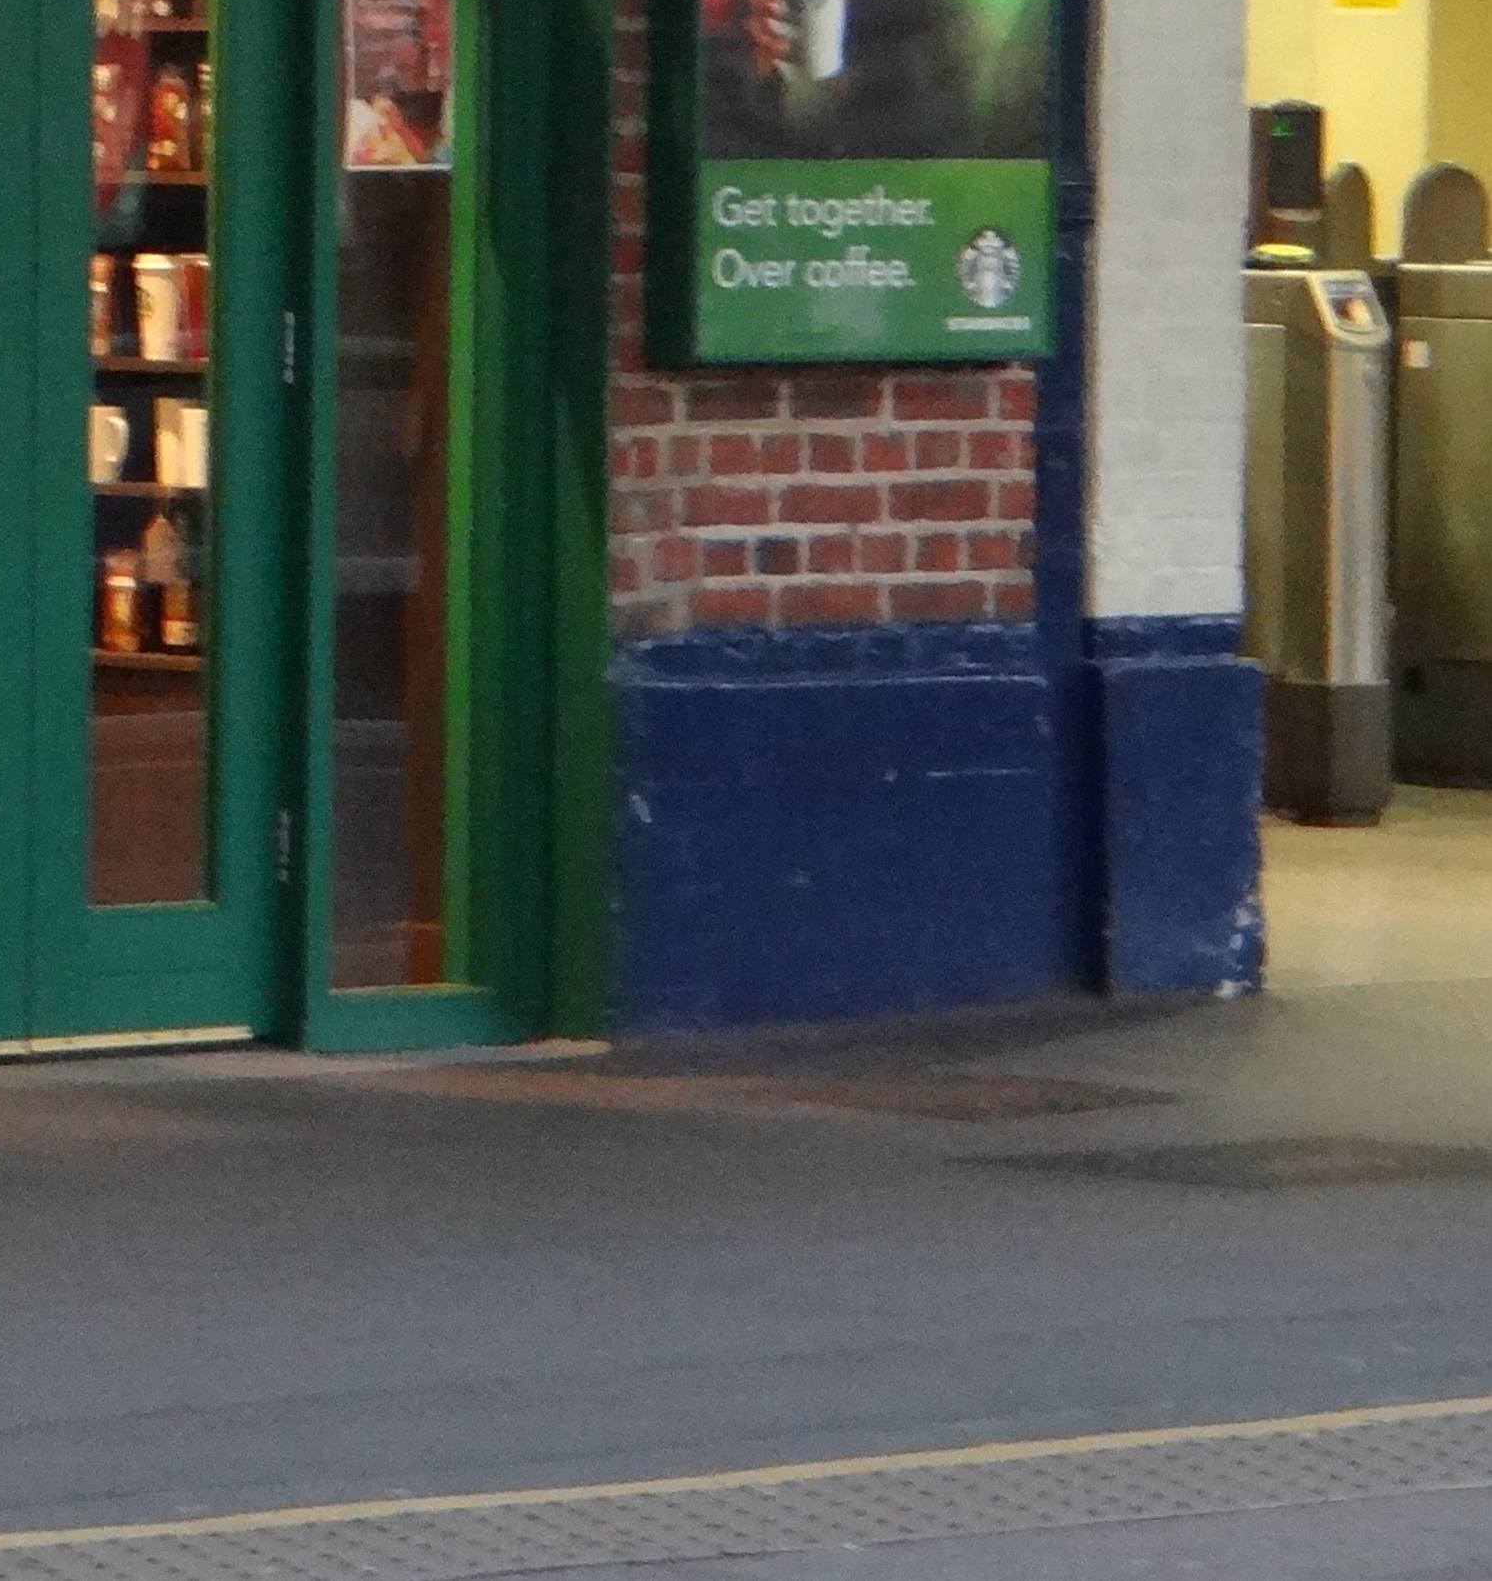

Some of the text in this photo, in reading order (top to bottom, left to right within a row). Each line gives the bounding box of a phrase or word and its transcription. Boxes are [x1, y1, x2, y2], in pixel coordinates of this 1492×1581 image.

[711, 185, 778, 228] Get
[711, 243, 917, 289] Over coffee.
